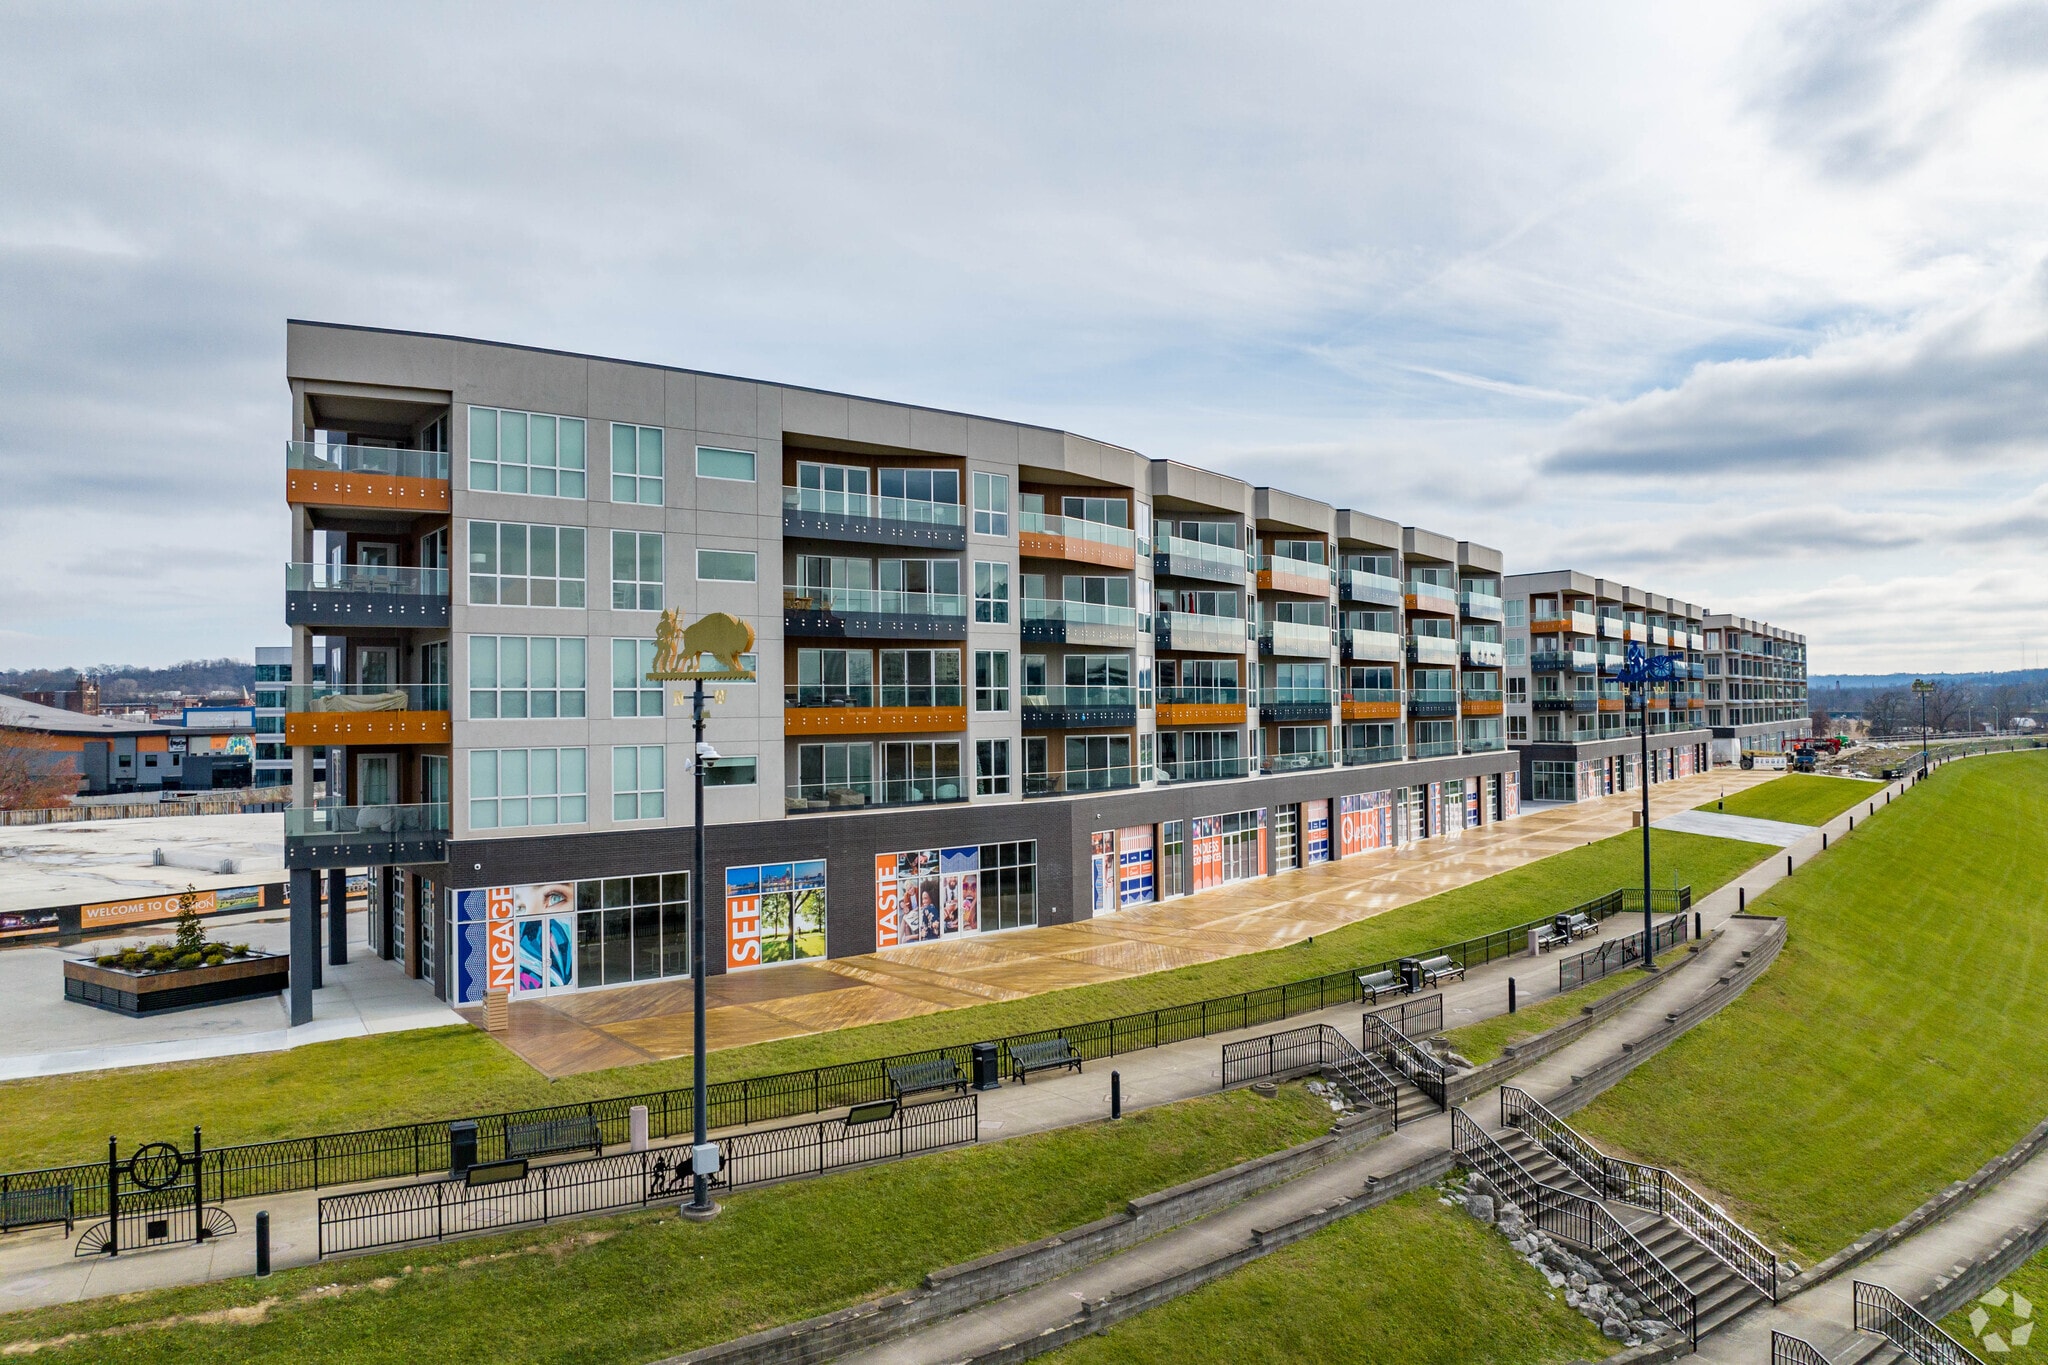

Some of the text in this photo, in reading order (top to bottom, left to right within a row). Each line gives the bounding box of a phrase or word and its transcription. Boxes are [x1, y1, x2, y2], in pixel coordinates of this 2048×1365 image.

[86, 903, 145, 918] WELCOME
[147, 901, 162, 911] TO
[732, 899, 760, 962] SEE
[878, 866, 898, 945] TASTE
